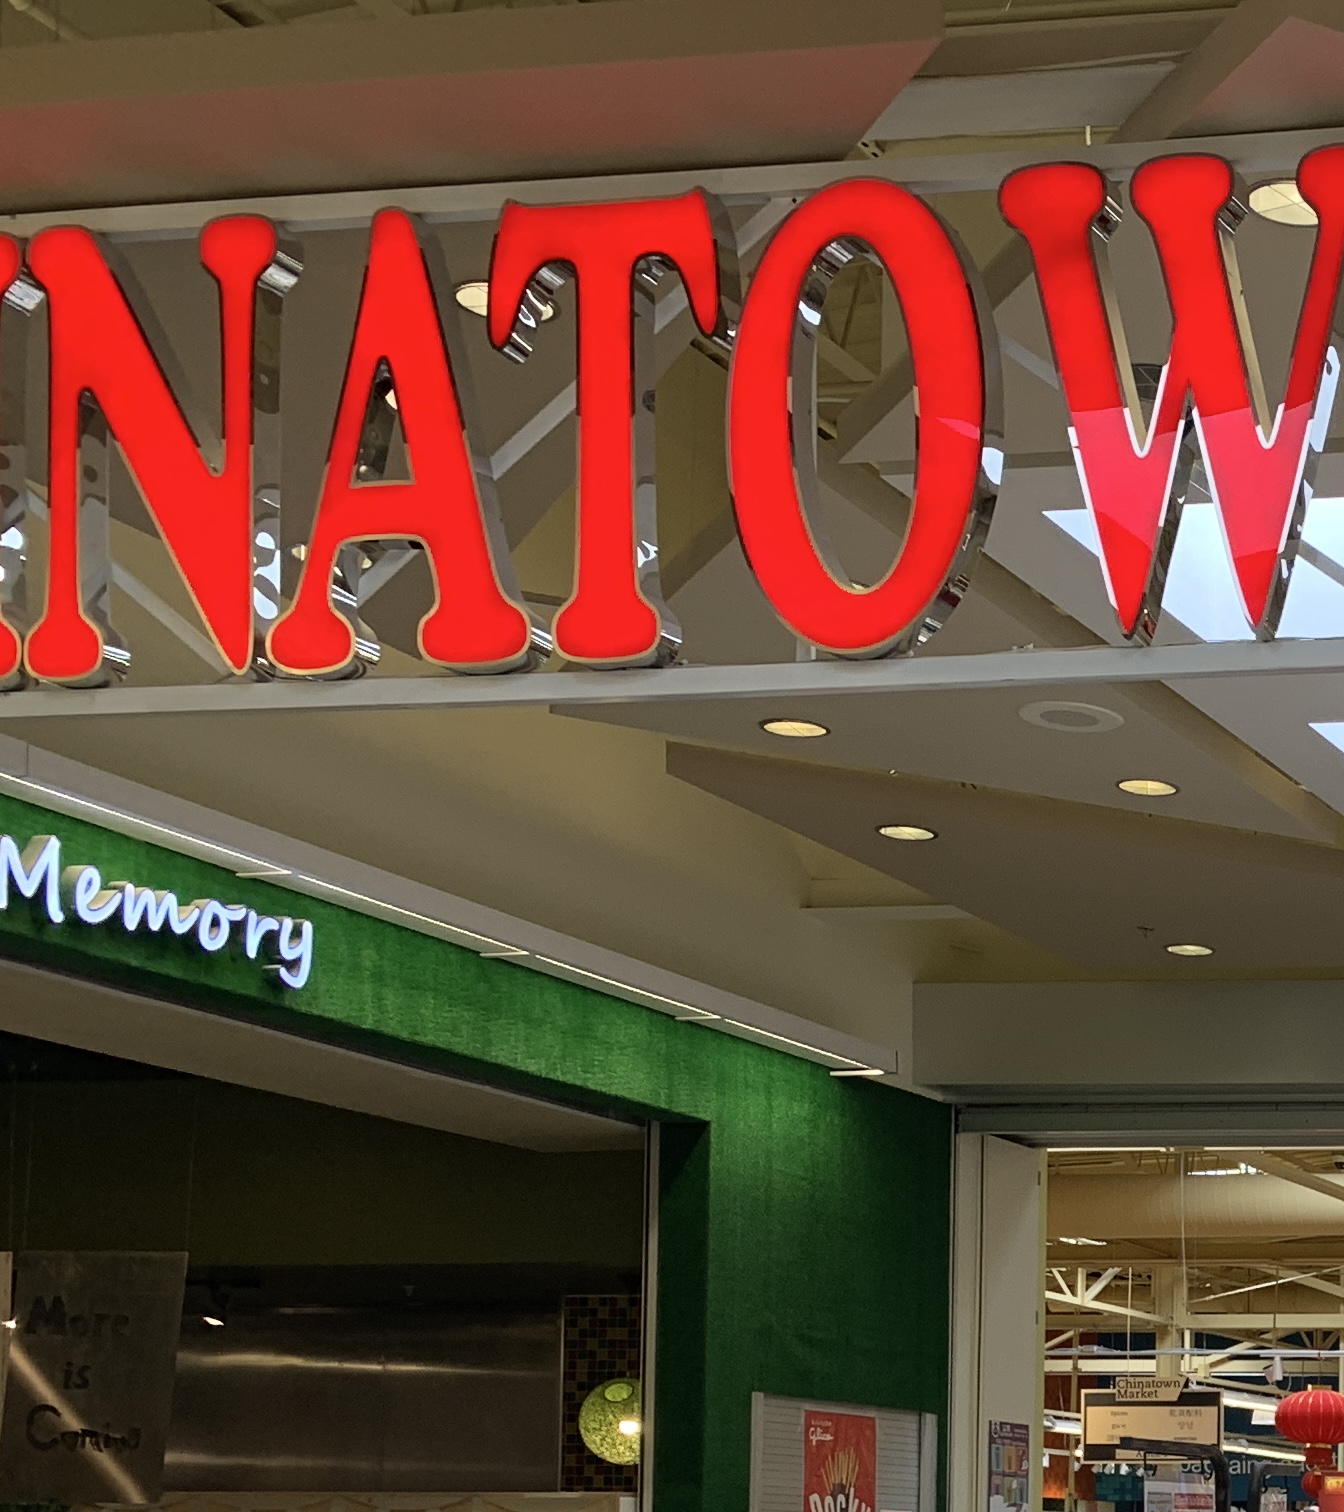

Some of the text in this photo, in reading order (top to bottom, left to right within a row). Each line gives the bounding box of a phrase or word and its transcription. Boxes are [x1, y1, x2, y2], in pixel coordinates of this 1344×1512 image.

[0, 834, 313, 989] Memory
[62, 1361, 91, 1390] is
[1116, 1378, 1181, 1391] Chinatown
[1116, 1389, 1160, 1399] Market
